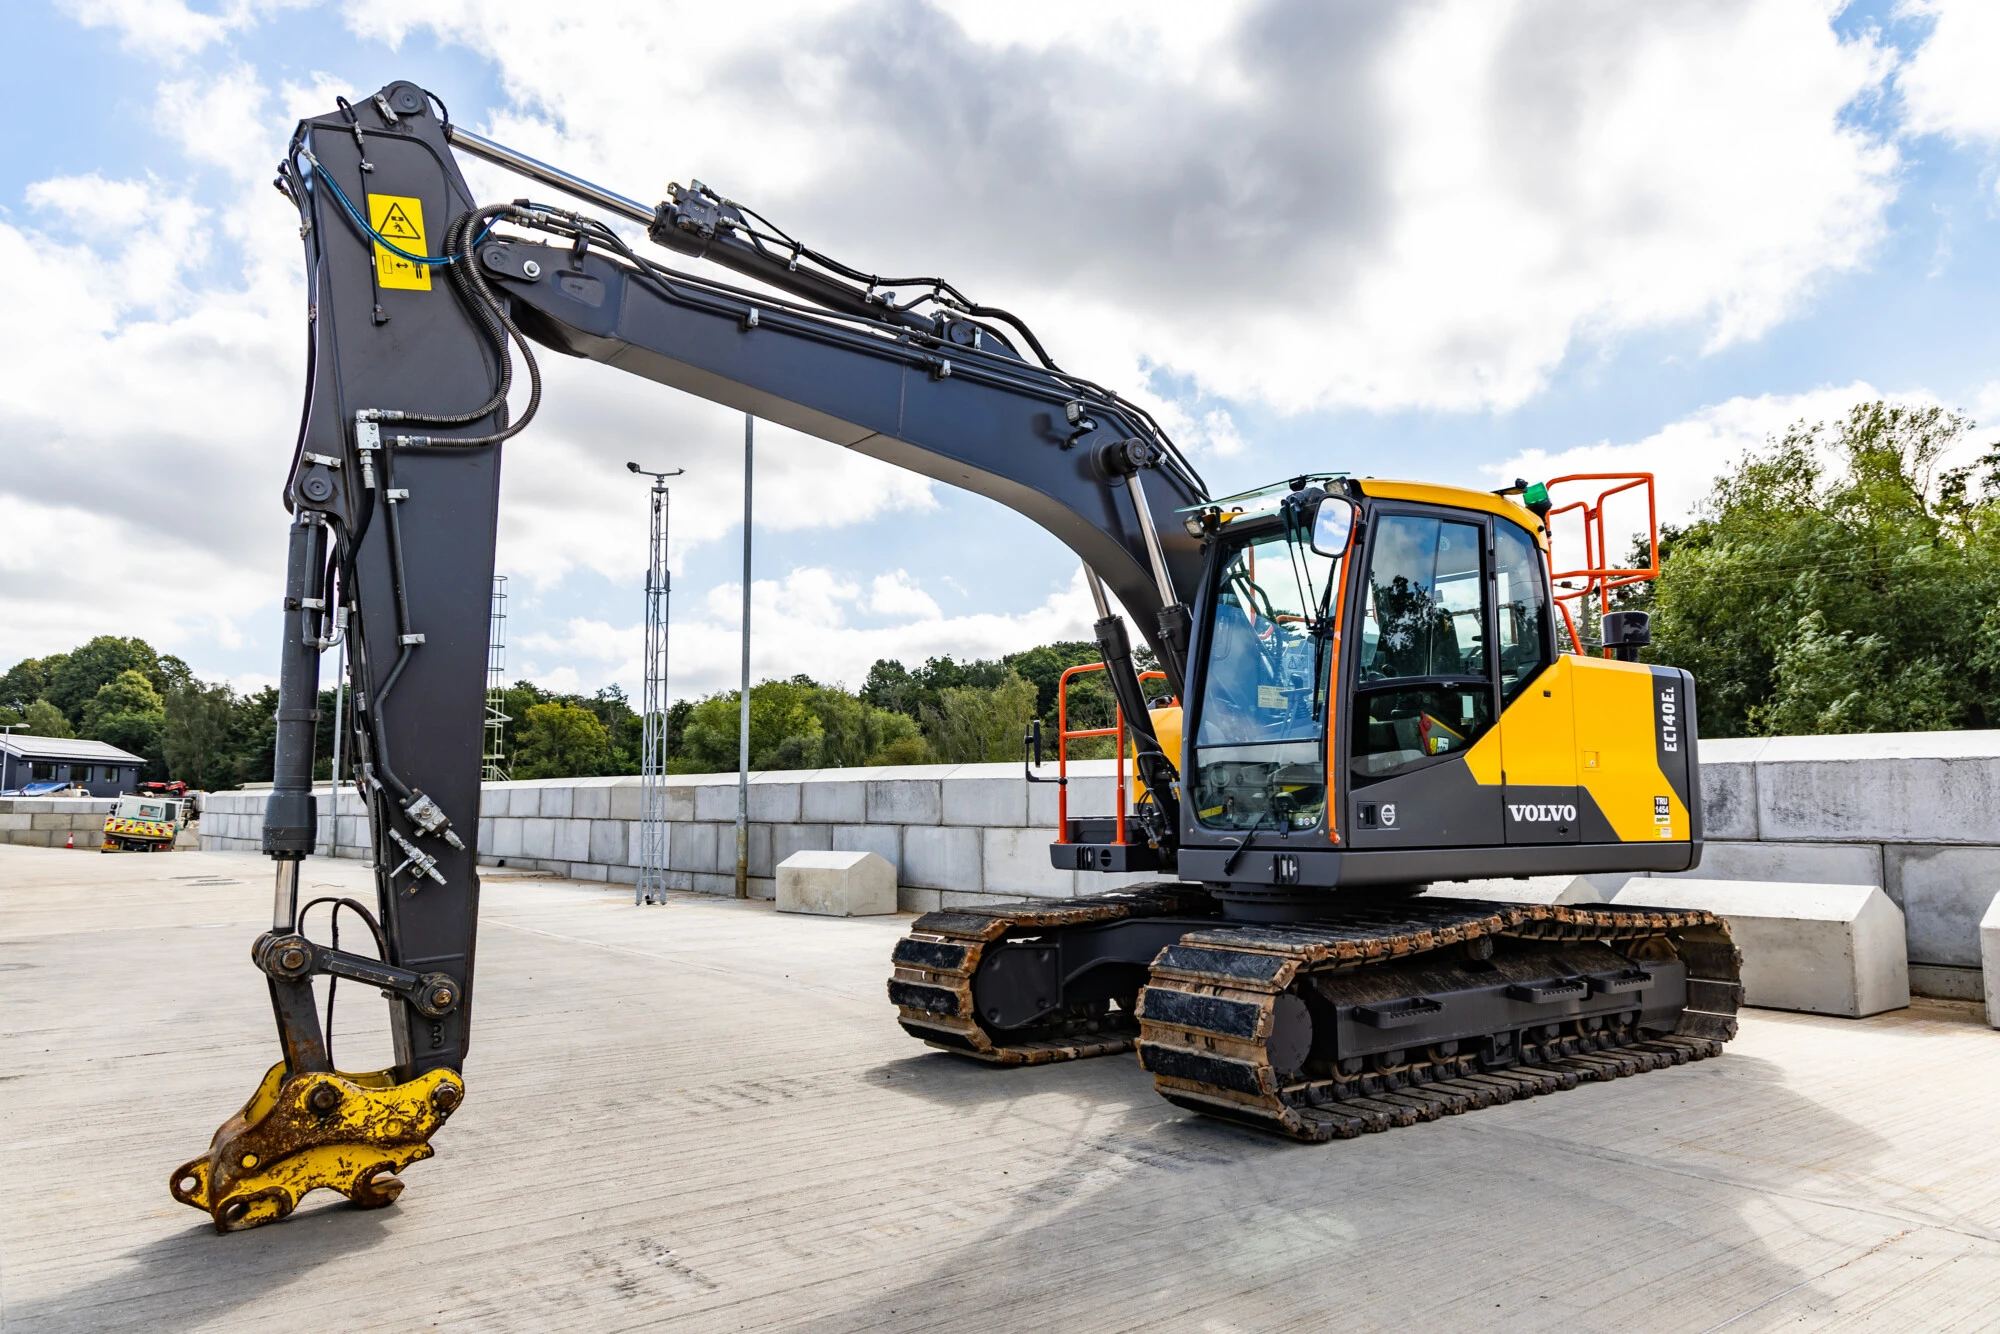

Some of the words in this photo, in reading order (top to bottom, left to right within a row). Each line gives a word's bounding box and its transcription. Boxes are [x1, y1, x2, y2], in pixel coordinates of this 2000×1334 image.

[1661, 686, 1678, 752] EC140EL
[1655, 796, 1668, 805] TRU
[1507, 804, 1577, 822] VOLVO
